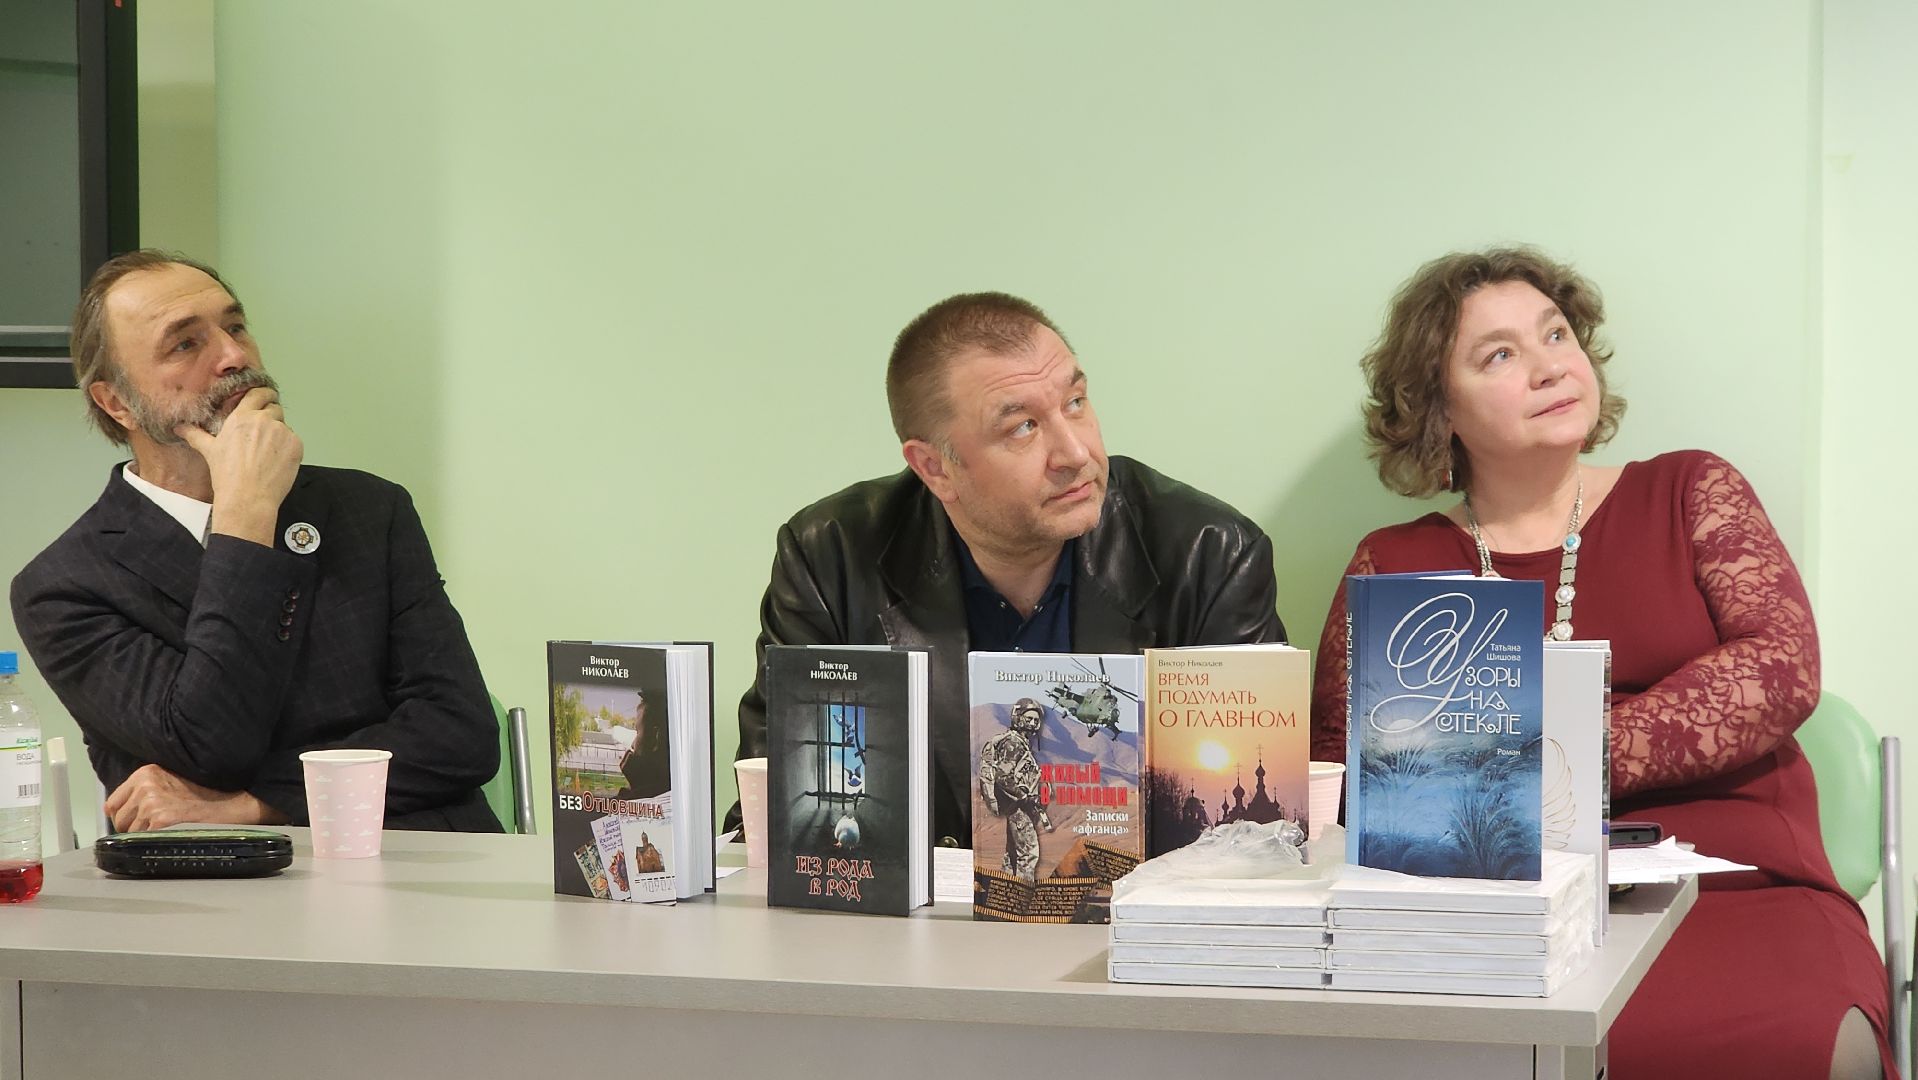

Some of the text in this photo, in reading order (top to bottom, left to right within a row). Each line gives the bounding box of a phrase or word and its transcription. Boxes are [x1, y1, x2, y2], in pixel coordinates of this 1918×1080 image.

[1490, 643, 1521, 652] Татьяна
[590, 656, 620, 668] Виктор
[1486, 653, 1521, 661] Шишова
[819, 661, 849, 672] Виктор
[1158, 660, 1185, 668] Виктор
[582, 667, 629, 679] НИКОЛАЕВ
[810, 670, 858, 681] НИКОЛАЕВ
[994, 669, 1110, 685] Виктор Николаев
[1158, 673, 1209, 686] ВРЕМЯ
[1158, 690, 1257, 705] ПОДУМАТЬ
[1470, 690, 1510, 710] НА
[1159, 710, 1296, 728] О ГЛАВНОМ
[1435, 713, 1521, 735] СТЕКЛЕ
[1497, 748, 1521, 756] Роман
[1040, 762, 1100, 784] ЖИВЫЙ
[1040, 787, 1128, 808] В ПОМОЩИ
[1086, 810, 1129, 822] Записки
[1073, 823, 1129, 835] «афганца»
[796, 856, 874, 881] ИЗ РОДА
[809, 878, 861, 902] В РОД
